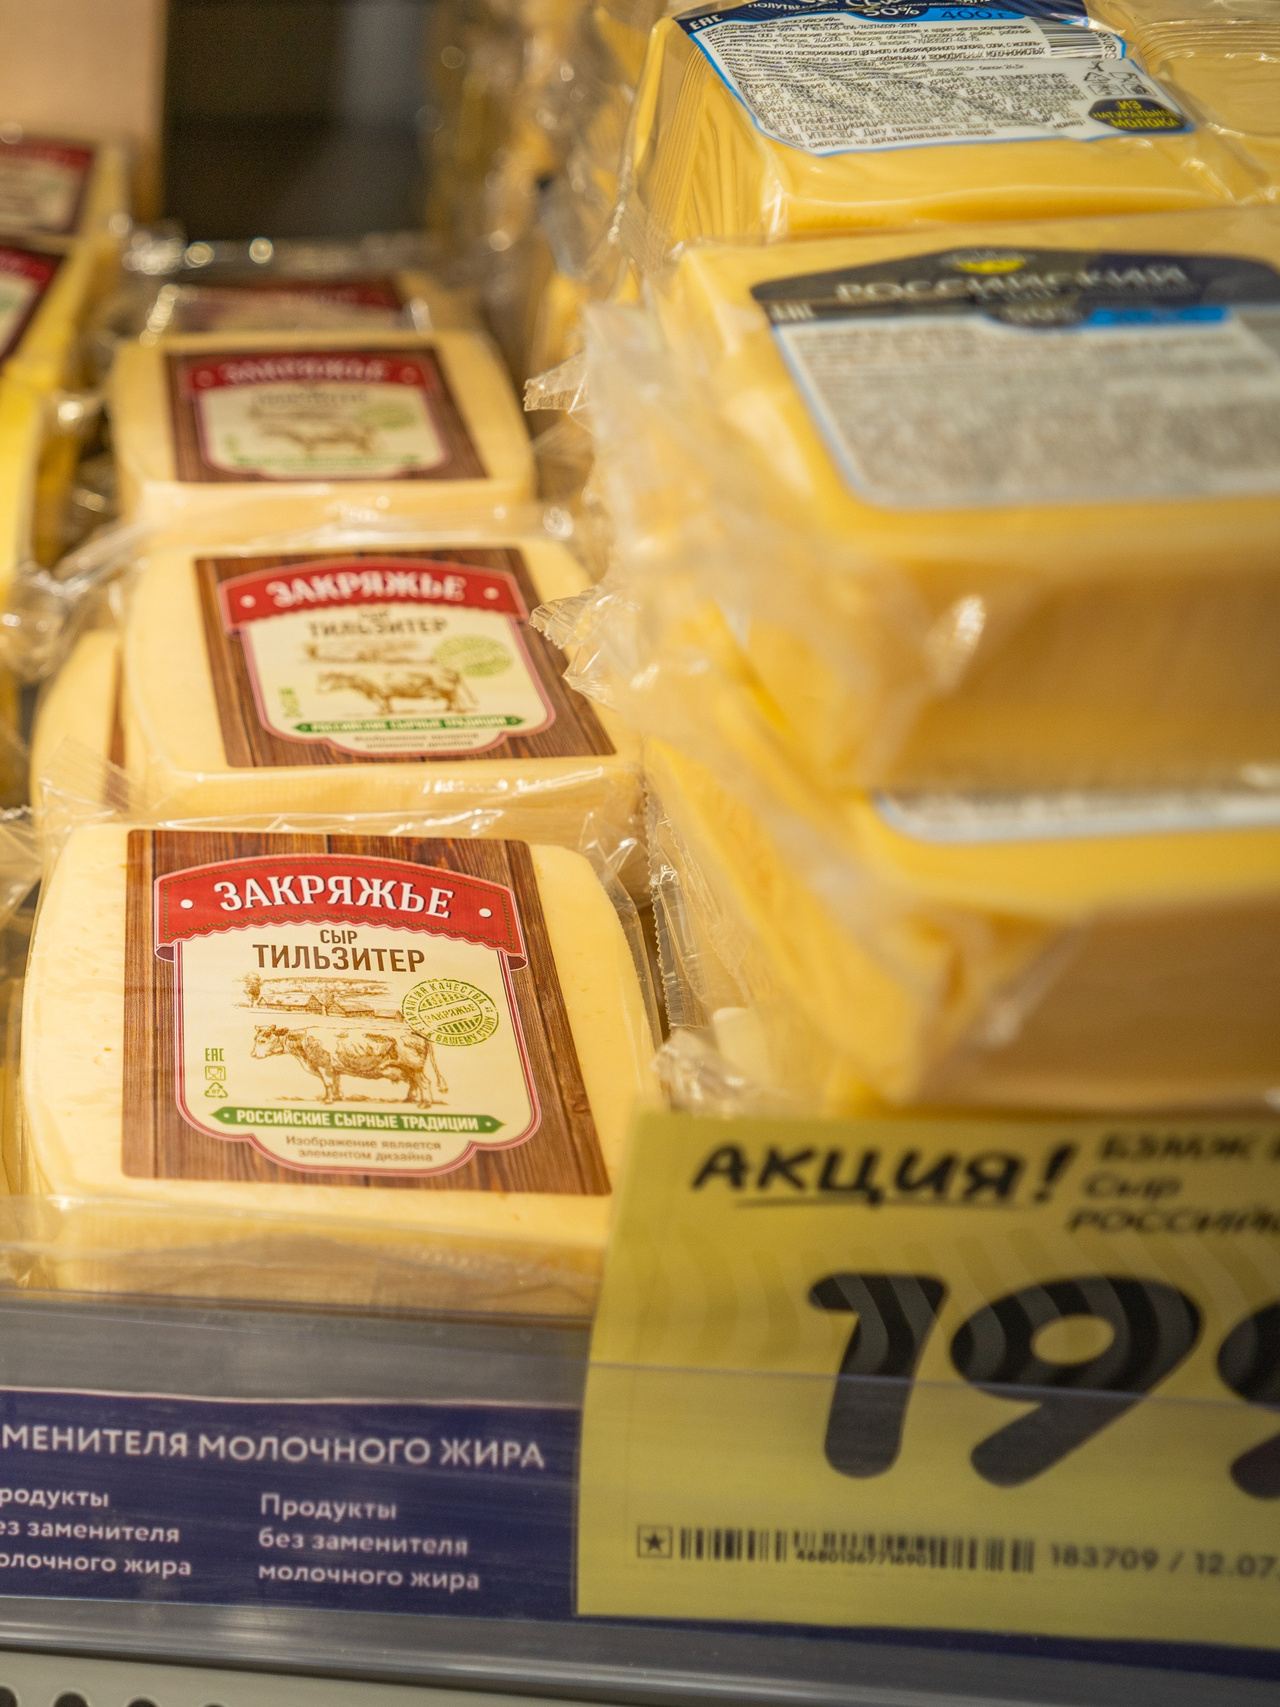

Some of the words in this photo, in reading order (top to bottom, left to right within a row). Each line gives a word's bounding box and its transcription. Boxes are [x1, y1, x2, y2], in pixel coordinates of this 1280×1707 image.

[863, 6, 920, 17] 50%
[940, 10, 993, 19] 400
[266, 569, 466, 607] ЗАКРЯЖЬЕ
[213, 873, 456, 920] ЗАКРЯЖЬЕ
[318, 928, 359, 945] СЫР
[252, 943, 426, 974] ТИЛЬЗИТЕР
[429, 981, 487, 1005] КАЧЕСТВА
[424, 1003, 477, 1023] ЗАКРЯЖЬЕ
[435, 1033, 479, 1045] ВАШЕМУ
[476, 1015, 496, 1039] СТОЛУ
[204, 1047, 225, 1062] EAC
[236, 1108, 332, 1127] РОССИЙСКИЕ
[334, 1112, 399, 1129] СЫРНЫЕ
[401, 1115, 479, 1133] ТРАДИЦИИ
[286, 1135, 378, 1149] Изображение
[381, 1138, 442, 1150] является
[298, 1148, 372, 1161] элементом
[375, 1150, 433, 1163] дизайна
[691, 1138, 1077, 1208] АКЦИЯ!
[807, 1269, 1280, 1501] 19
[199, 1433, 431, 1466] МОЛОЧНОГО
[438, 1437, 546, 1471] ЖИРА
[260, 1494, 397, 1524] Продукты
[26, 1519, 180, 1544] заменителя
[258, 1527, 305, 1551] без
[311, 1533, 469, 1557] заменителя
[123, 1555, 192, 1579] жира
[1051, 1541, 1160, 1572] 183709
[258, 1563, 404, 1590] молочного
[410, 1571, 480, 1594] жира
